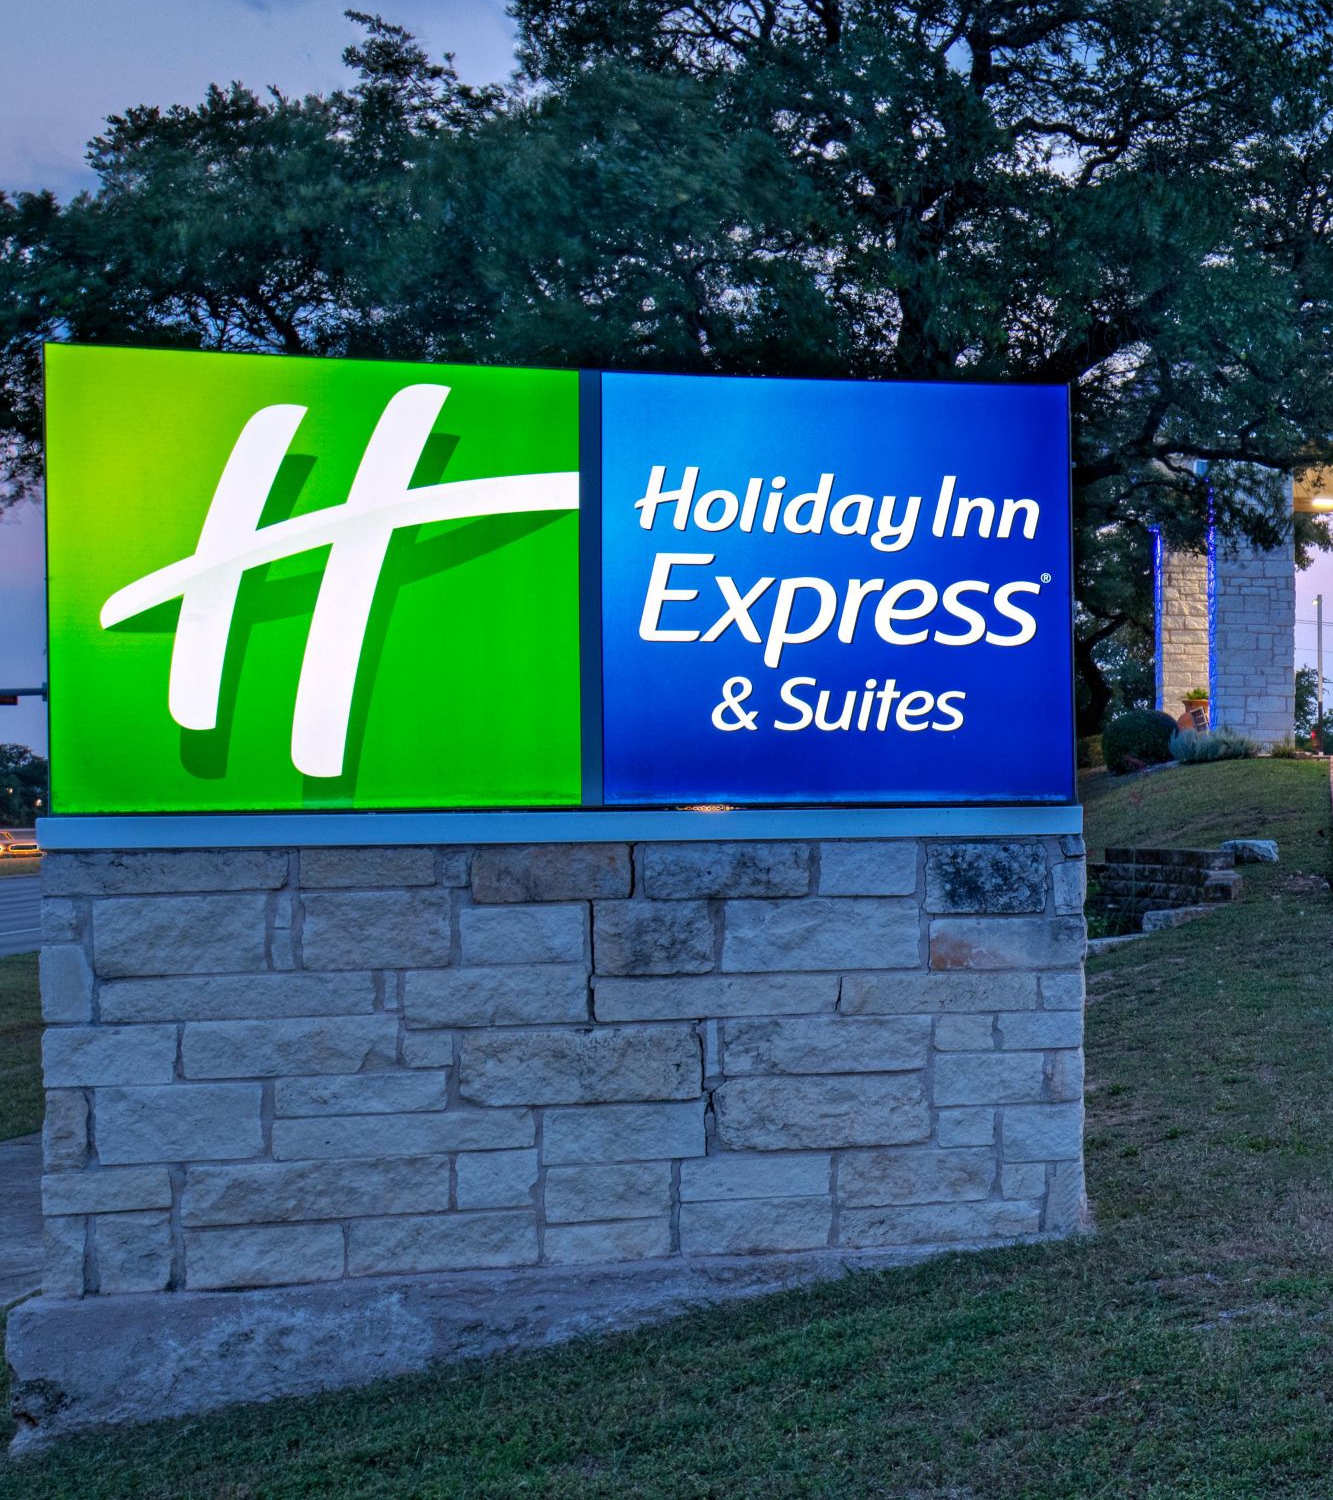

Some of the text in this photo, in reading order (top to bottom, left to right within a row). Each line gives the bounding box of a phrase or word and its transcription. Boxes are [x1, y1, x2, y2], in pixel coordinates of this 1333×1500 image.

[634, 465, 1041, 553] Holiday Inn
[711, 676, 967, 732] & Suites
